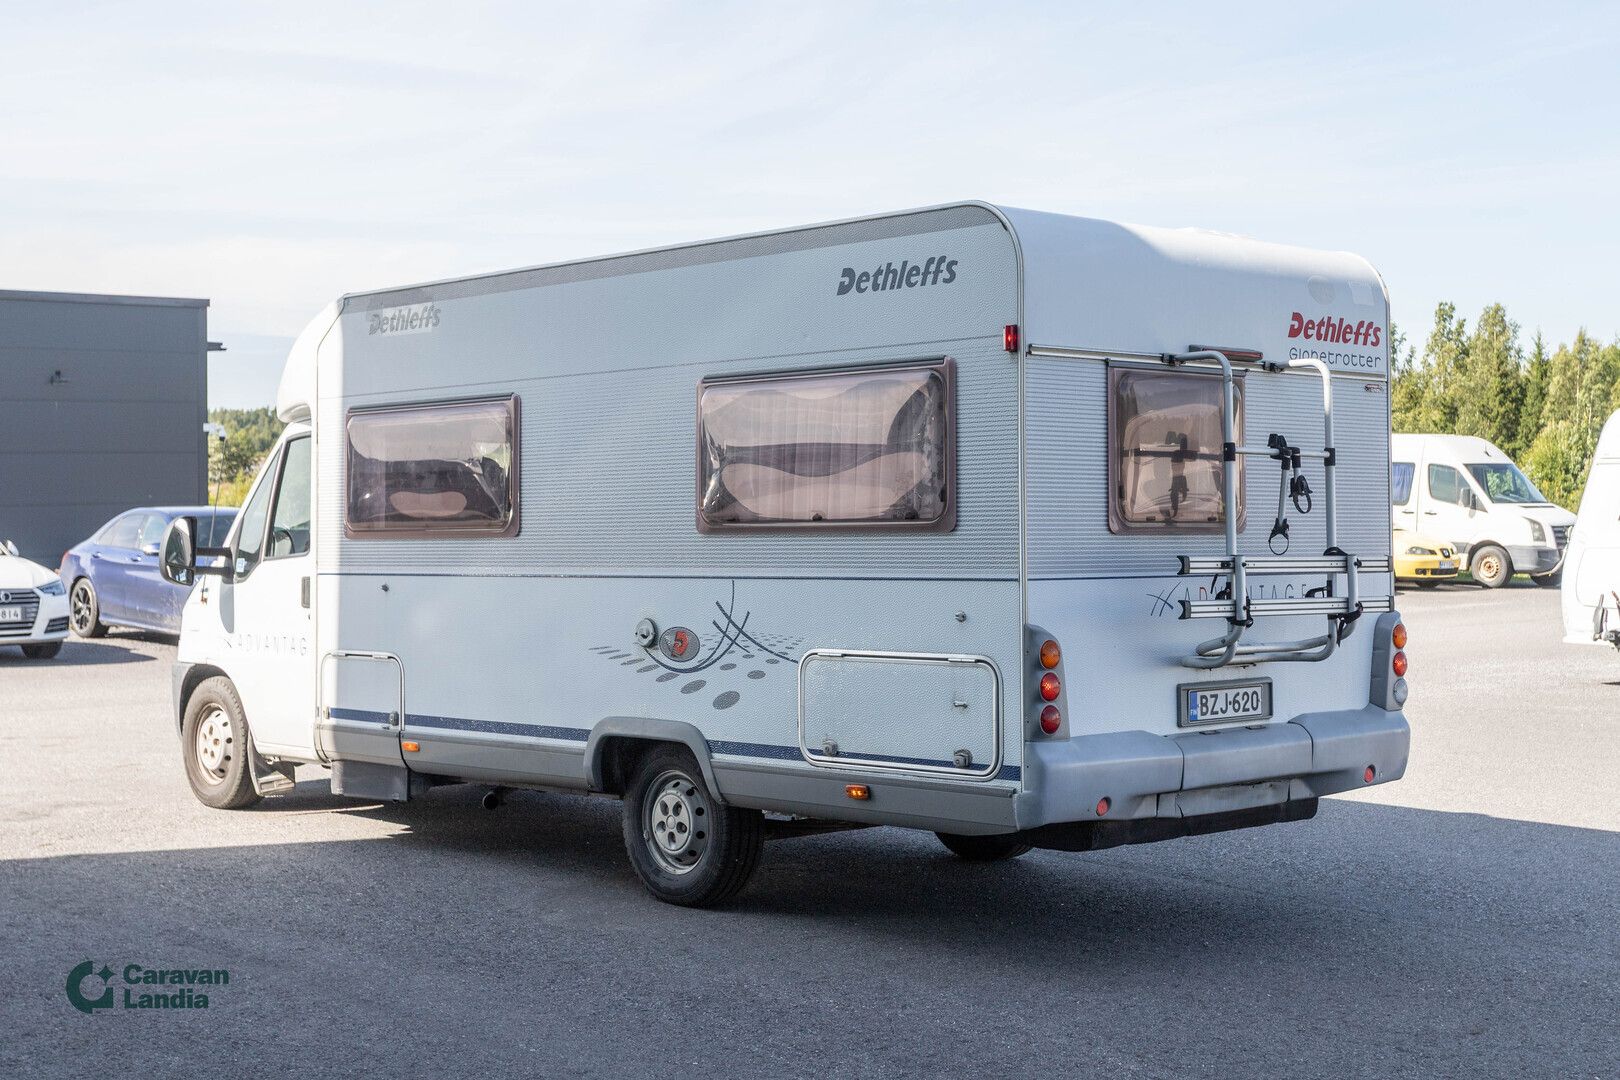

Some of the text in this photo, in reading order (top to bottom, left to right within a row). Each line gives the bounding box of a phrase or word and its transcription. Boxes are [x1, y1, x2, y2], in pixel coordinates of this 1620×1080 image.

[837, 255, 958, 295] Dethleffs
[368, 304, 441, 336] Dethleffs
[1288, 312, 1381, 347] Dethleffs
[1200, 690, 1259, 717] BZJ-620
